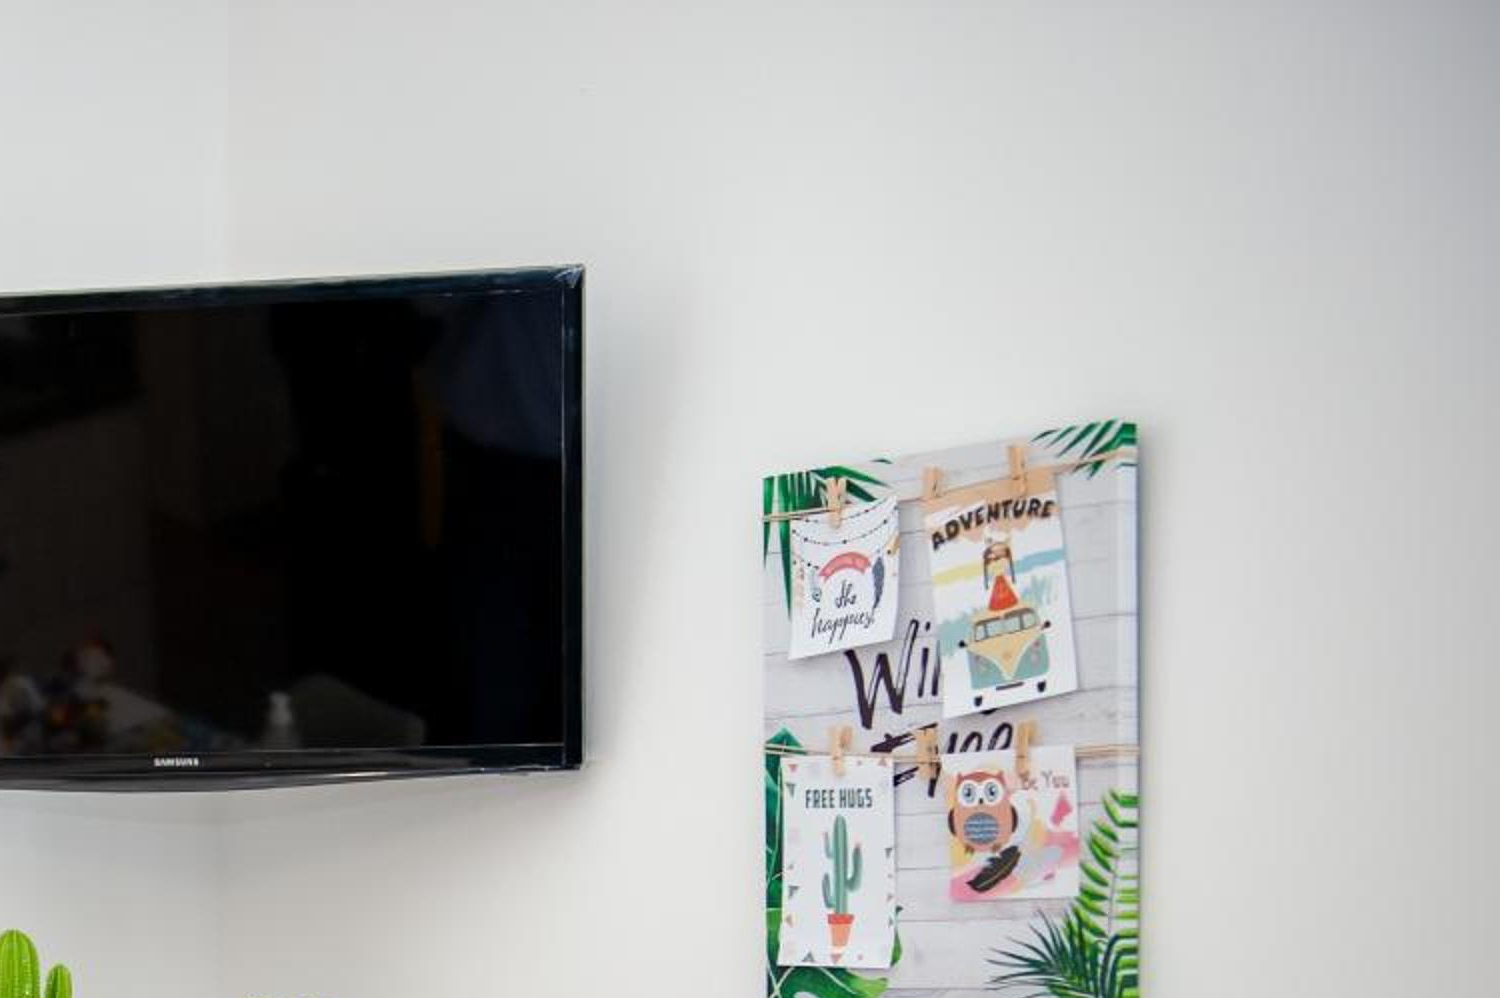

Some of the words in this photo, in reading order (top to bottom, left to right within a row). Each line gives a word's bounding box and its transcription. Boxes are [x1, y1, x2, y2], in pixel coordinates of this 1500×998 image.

[930, 497, 1056, 551] ADVENTURE
[153, 756, 200, 768] SAMSUNG
[804, 788, 836, 810] FREE
[838, 786, 874, 809] HUGS
